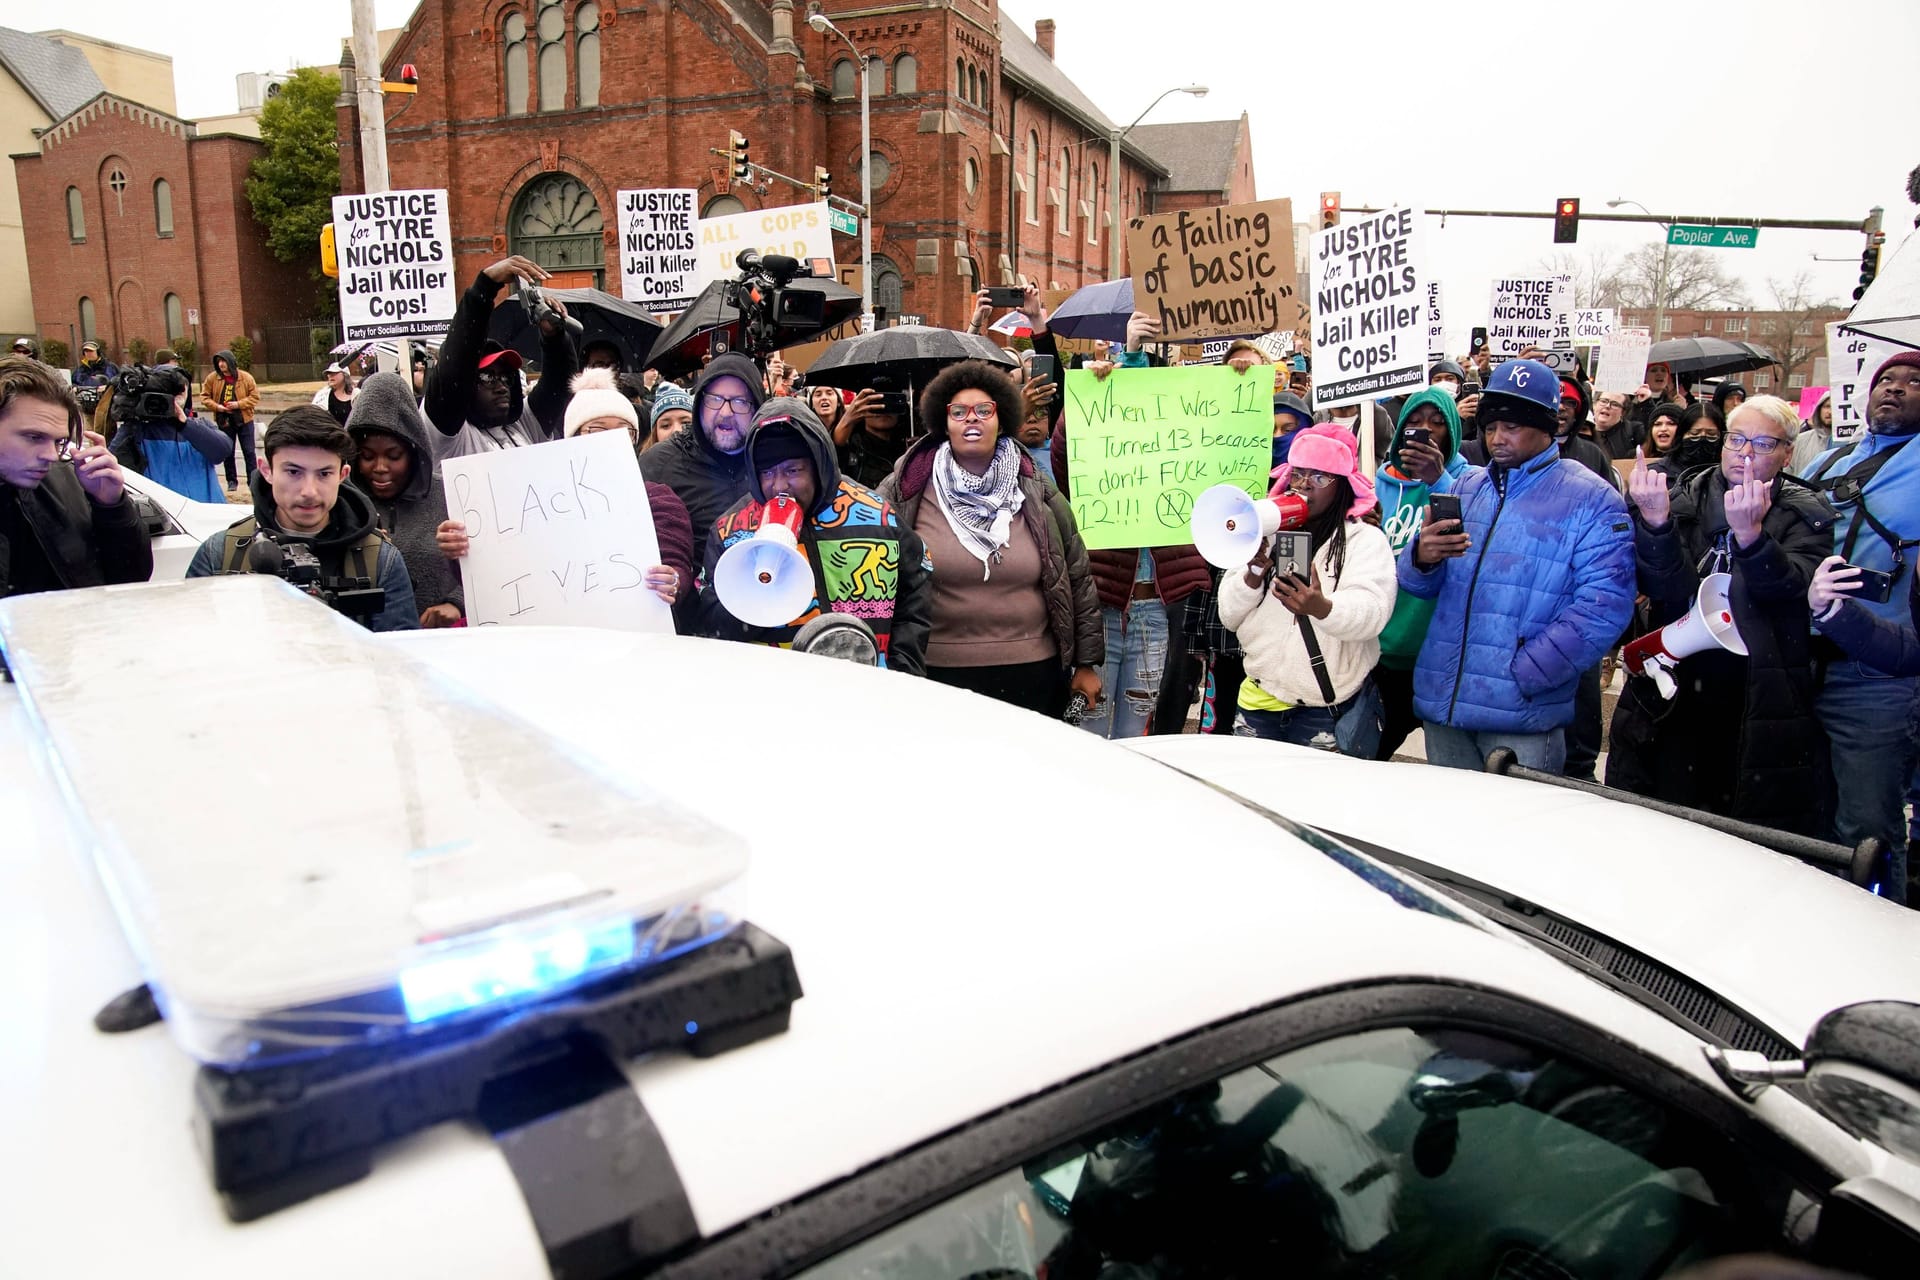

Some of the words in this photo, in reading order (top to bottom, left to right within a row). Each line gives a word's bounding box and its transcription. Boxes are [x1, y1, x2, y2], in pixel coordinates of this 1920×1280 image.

[344, 194, 437, 221] JUSTICE
[626, 193, 691, 211] JUSTICE
[350, 223, 369, 246] for
[375, 218, 434, 241] TYRE
[630, 213, 644, 234] for
[649, 213, 689, 231] TYRE
[703, 223, 738, 245] ALL
[761, 210, 818, 234] COPS
[1175, 207, 1270, 255] failing
[1319, 208, 1413, 261] JUSTICE
[1672, 228, 1714, 245] Poplar
[1722, 231, 1751, 245] Ave.
[346, 241, 443, 268] NICHOLS
[627, 232, 694, 251] NICHOLS
[627, 256, 654, 275] Jail
[660, 254, 697, 273] Killer
[1144, 252, 1170, 294] of
[1189, 247, 1276, 288] basic
[1323, 261, 1342, 289] for
[1348, 239, 1408, 279] TYRE
[346, 271, 383, 294] Jail
[390, 268, 447, 291] Killer
[643, 275, 684, 298] Cops!
[1318, 266, 1416, 316] NICHOLS
[1497, 280, 1553, 293] JUSTICE
[369, 294, 427, 320] Cops!
[1158, 281, 1293, 335] humanity"
[1493, 307, 1552, 320] NICHOLS
[1515, 294, 1549, 306] TYRE
[349, 328, 366, 338] Party
[367, 327, 377, 336] for
[377, 325, 409, 335] Socialism
[410, 323, 416, 332] &
[1317, 315, 1353, 347] Jail
[1360, 304, 1420, 337] Killer
[1576, 311, 1603, 324] YRE
[1490, 325, 1513, 338] Jail
[1517, 325, 1552, 338] Killer
[1256, 335, 1285, 358] ATTER
[1338, 335, 1397, 373] Cops!
[1318, 388, 1335, 399] Party
[1335, 385, 1345, 395] for
[1345, 379, 1378, 394] Socialism
[1379, 377, 1385, 387] &
[1386, 370, 1421, 385] Liberation
[1509, 365, 1531, 388] KC
[1068, 379, 1146, 427] When
[1152, 394, 1168, 420] I
[1231, 381, 1262, 414] 11
[1070, 438, 1086, 462] I
[1101, 432, 1160, 459] Turned
[1167, 428, 1192, 451] 13
[1201, 427, 1269, 450] because
[1072, 475, 1092, 498] I
[1099, 466, 1149, 495] don't
[1078, 498, 1140, 532] 12!!!
[471, 553, 643, 626] LIVES
